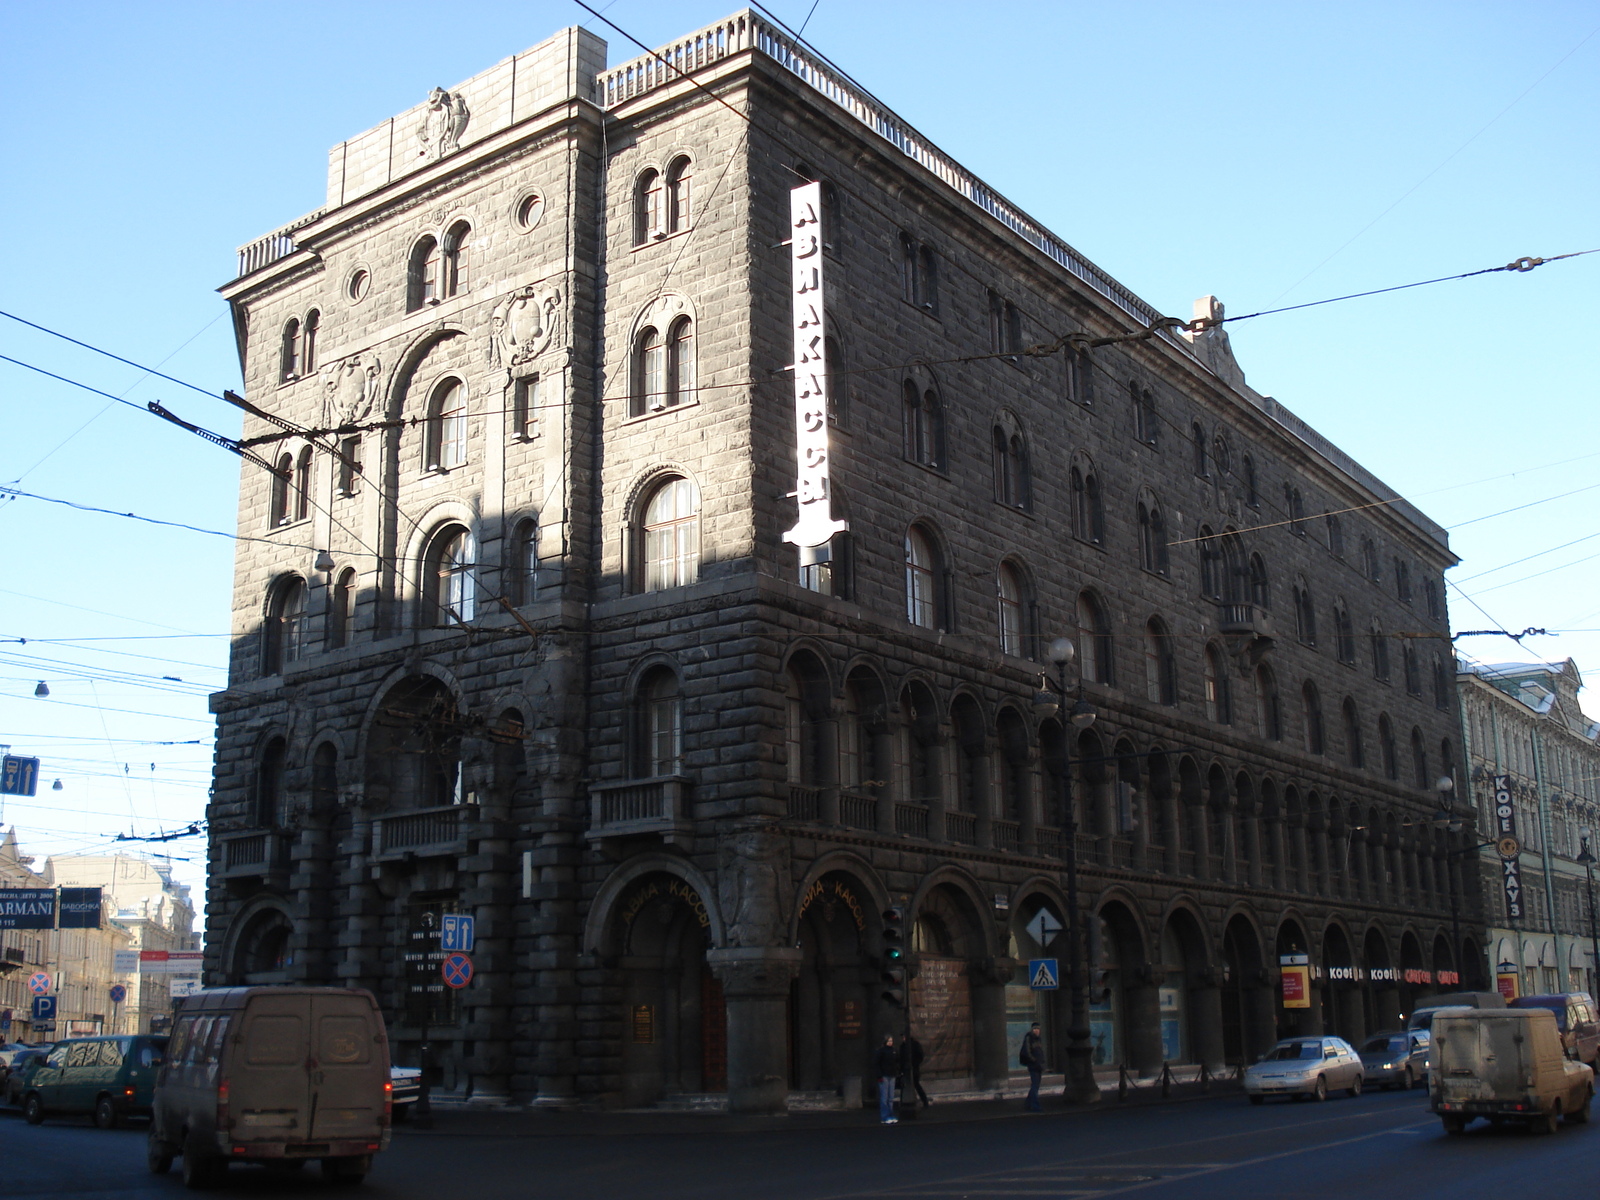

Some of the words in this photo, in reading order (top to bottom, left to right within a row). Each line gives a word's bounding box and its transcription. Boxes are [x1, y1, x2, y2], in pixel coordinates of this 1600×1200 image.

[795, 202, 827, 505] АВИАКАССЫ
[1495, 777, 1513, 832] КОФЕ
[622, 882, 659, 925] АВИА
[669, 880, 710, 928] КАССЫ
[834, 880, 867, 931] КАССЫ
[1504, 861, 1521, 917] ХАУЗ
[38, 998, 52, 1016] P
